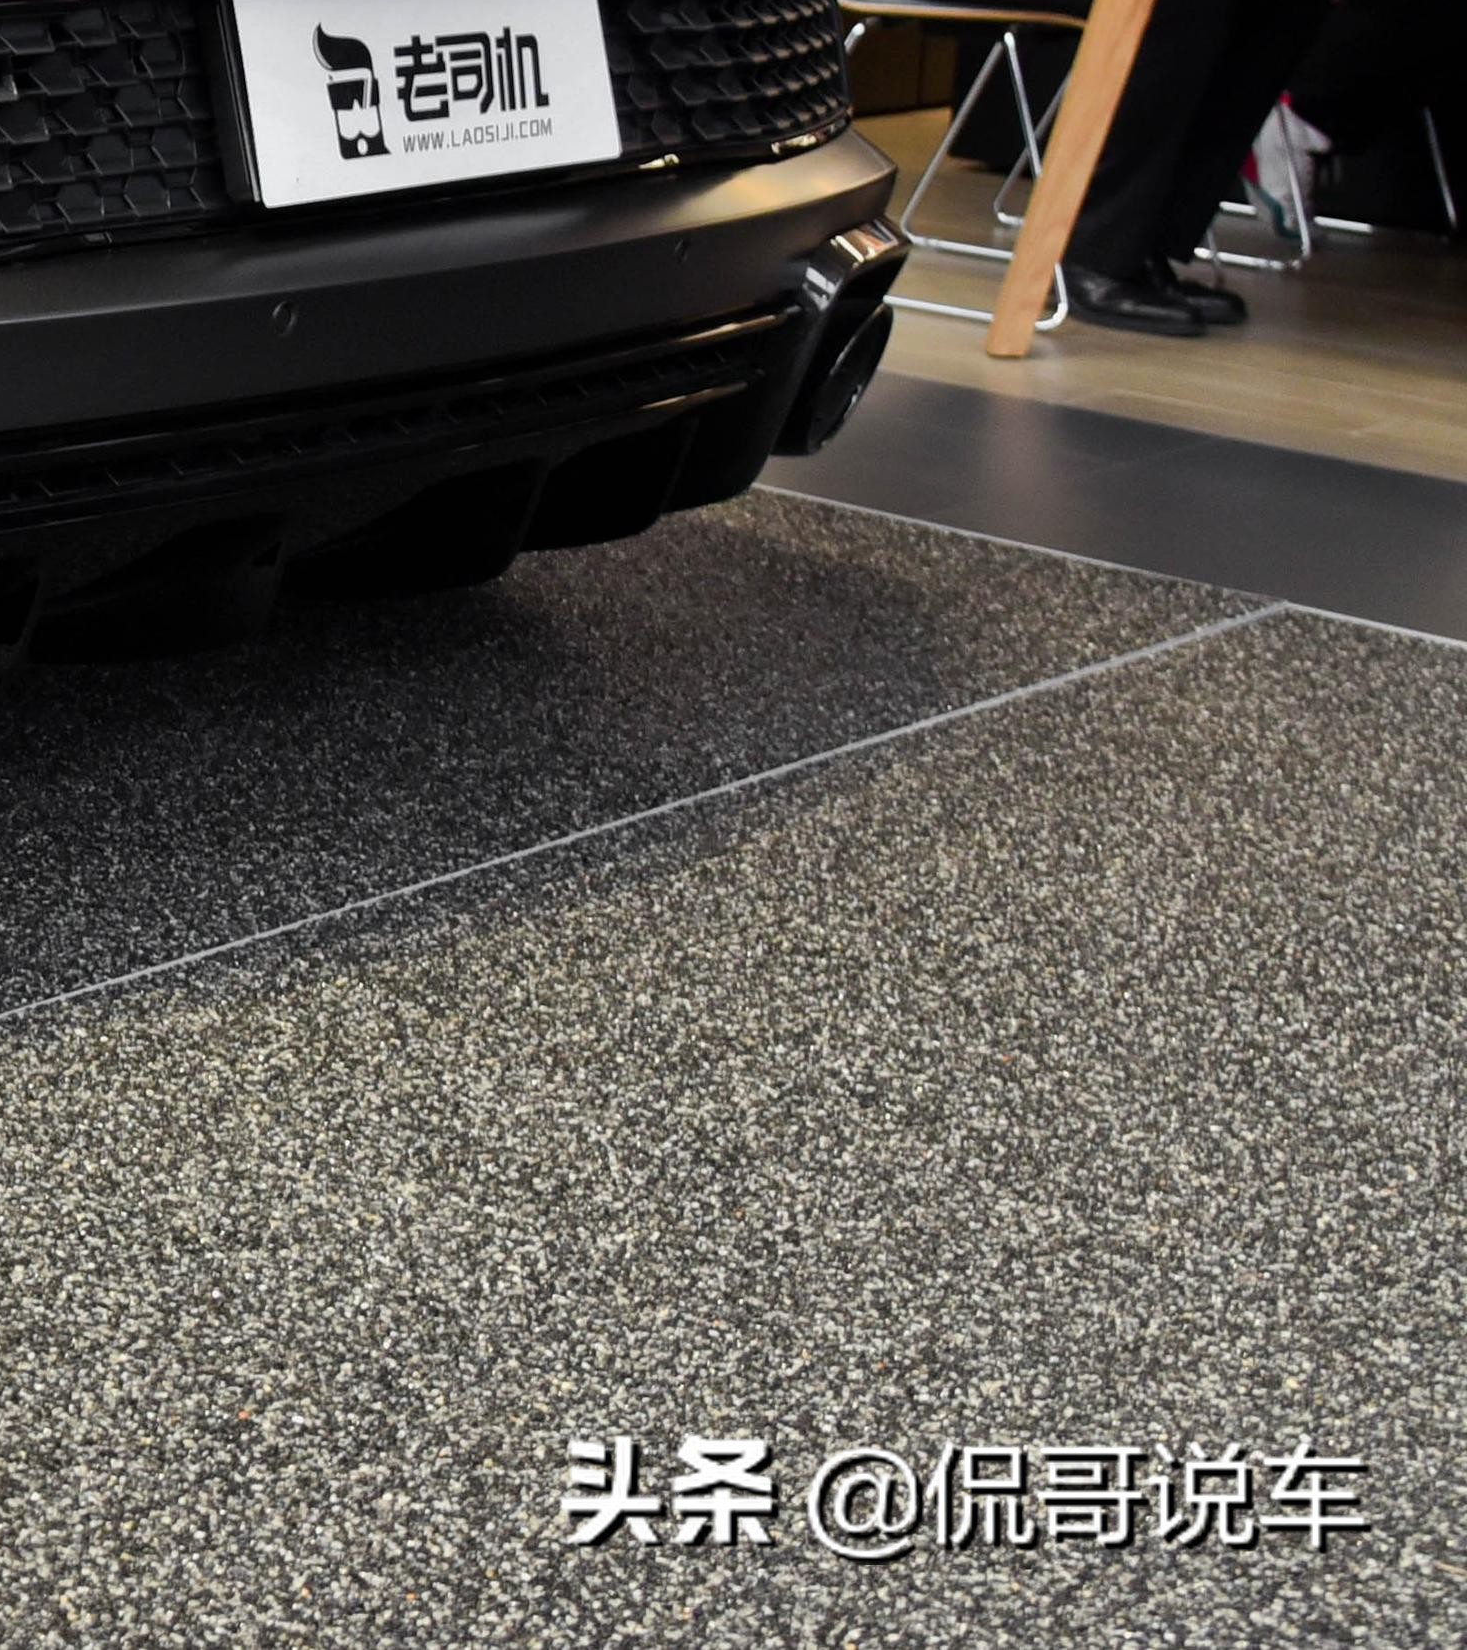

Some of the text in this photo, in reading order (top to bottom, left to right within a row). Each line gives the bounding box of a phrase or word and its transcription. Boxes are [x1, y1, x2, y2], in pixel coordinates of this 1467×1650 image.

[393, 26, 550, 122] 老司机
[402, 117, 554, 154] WWW.LAOSIJI.COM
